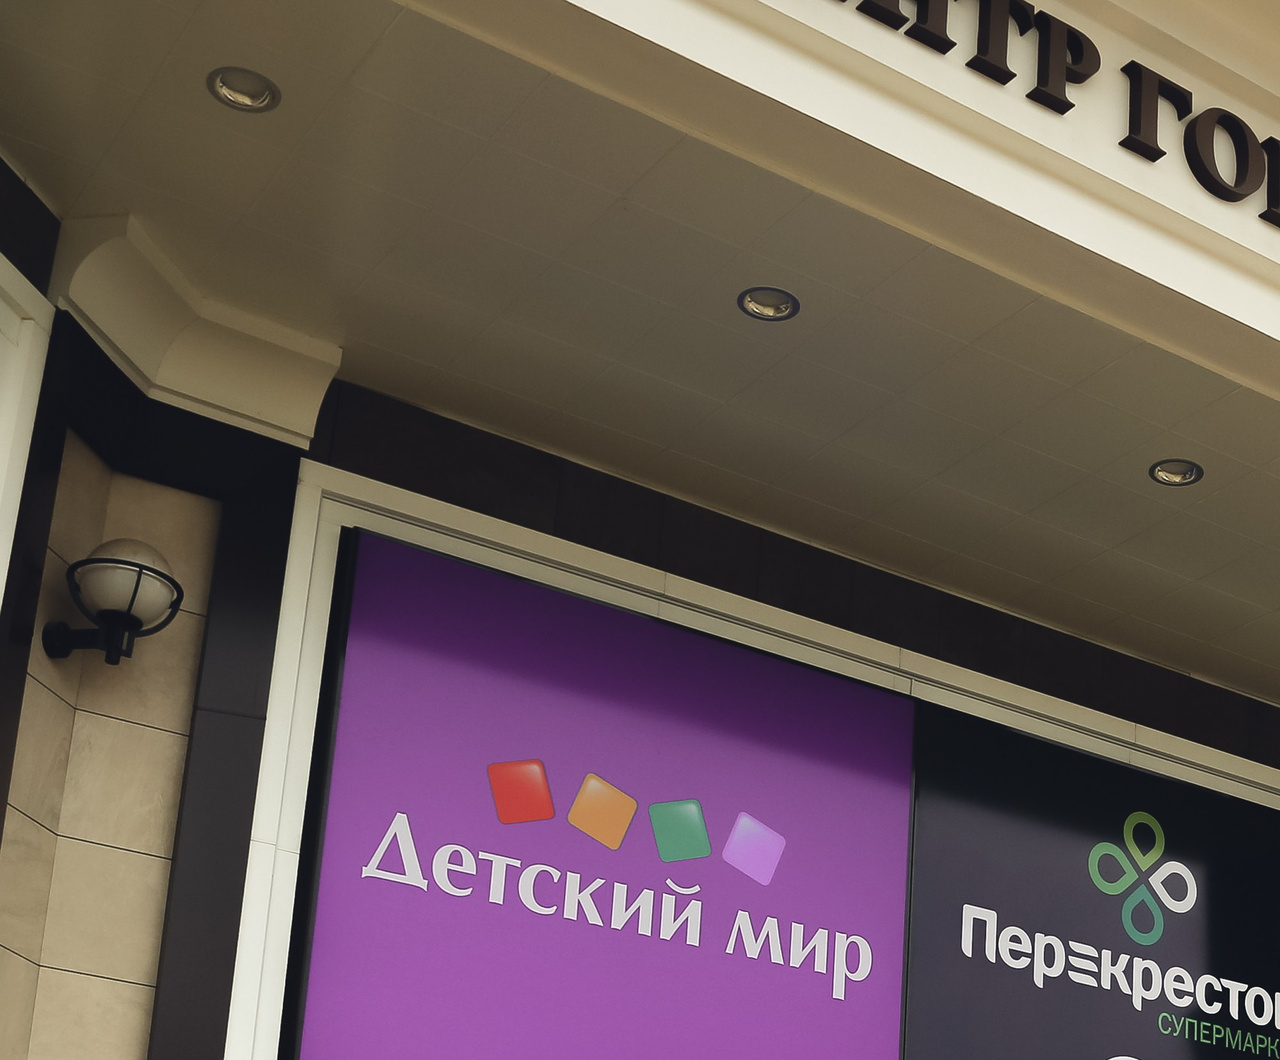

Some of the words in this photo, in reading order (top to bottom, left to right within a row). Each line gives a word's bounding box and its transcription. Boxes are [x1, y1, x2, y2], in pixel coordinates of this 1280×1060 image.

[837, 0, 1101, 116] ТР
[360, 811, 703, 948] Детский
[724, 909, 874, 1001] мир
